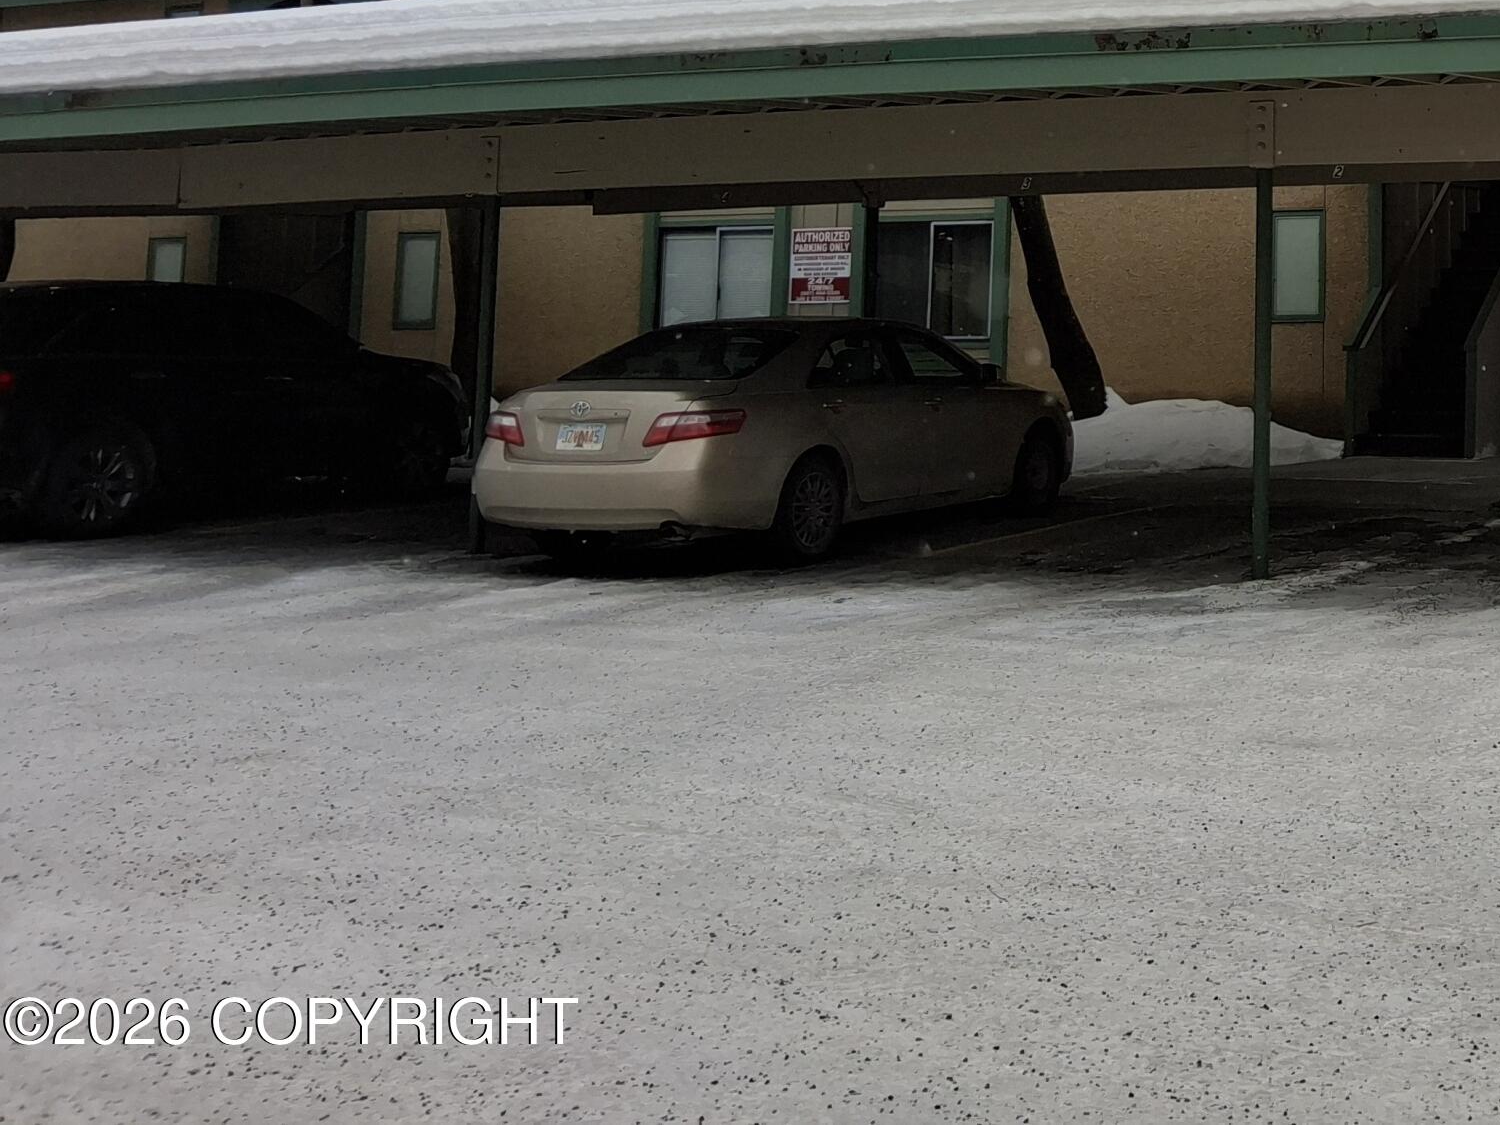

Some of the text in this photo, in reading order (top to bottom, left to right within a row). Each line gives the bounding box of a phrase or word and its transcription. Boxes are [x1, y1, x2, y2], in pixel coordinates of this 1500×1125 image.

[794, 231, 851, 243] AUTHORIZED
[794, 242, 850, 253] PARKING ONLY
[807, 277, 835, 285] 24/7
